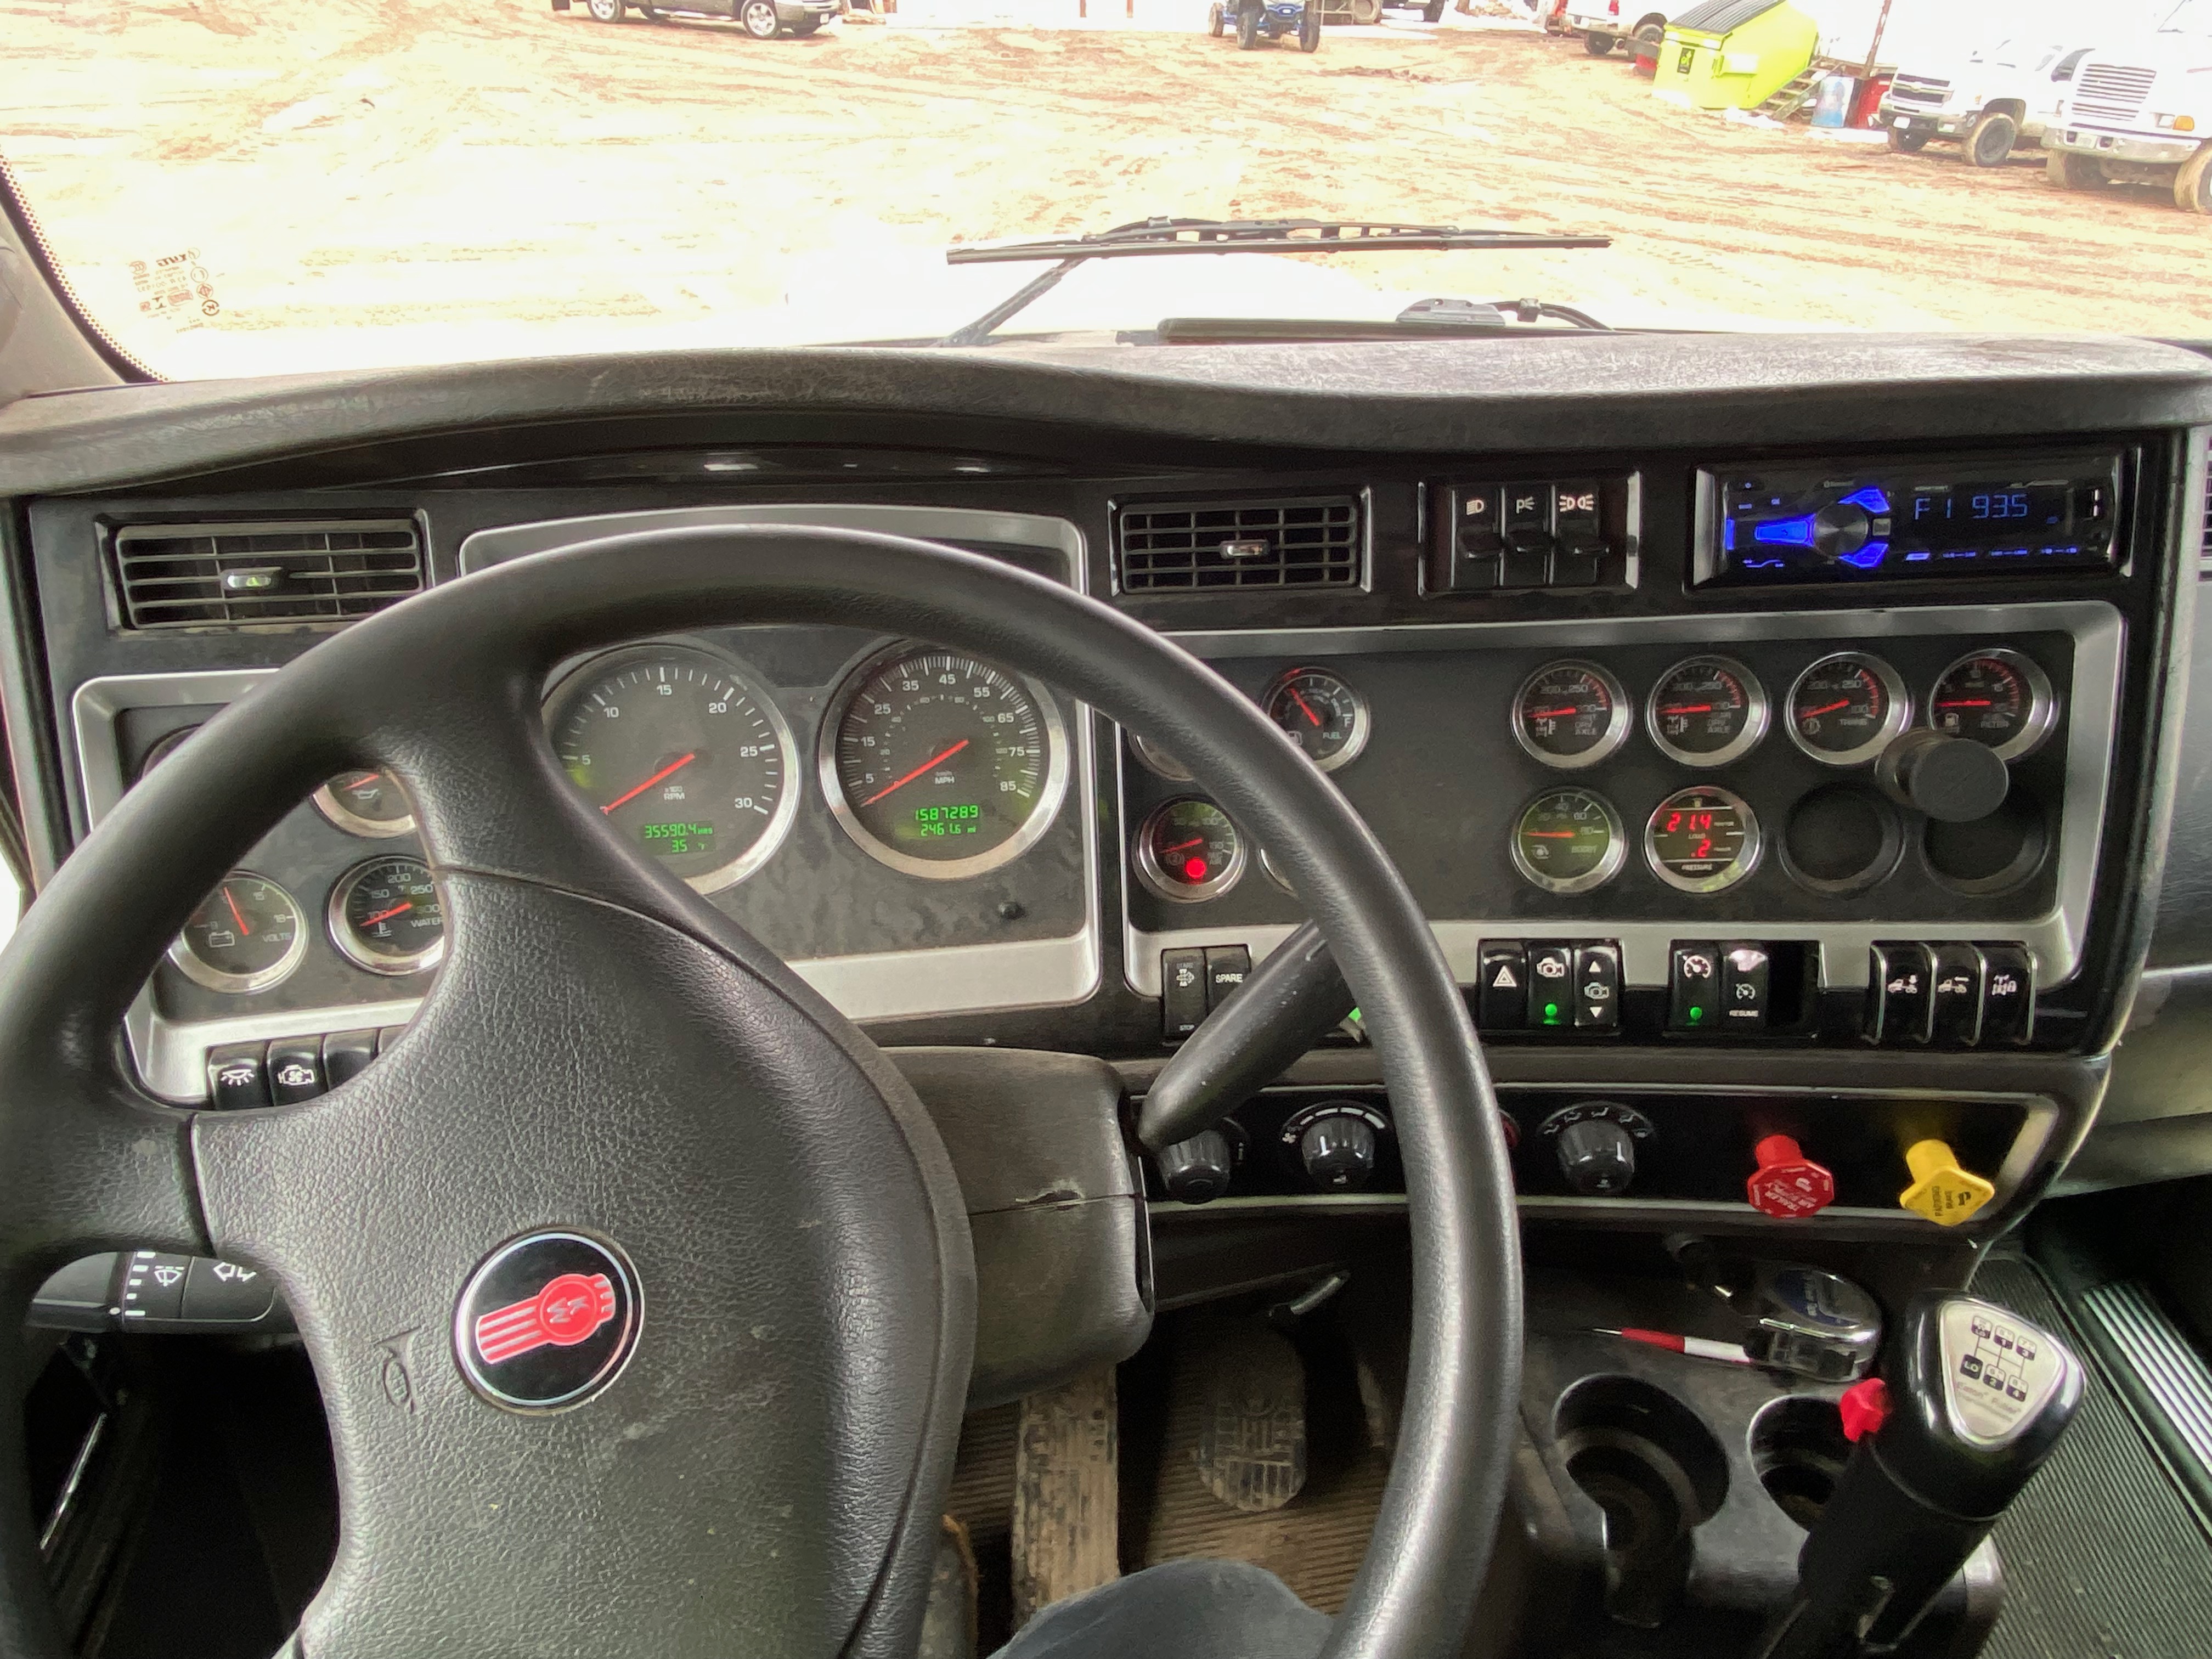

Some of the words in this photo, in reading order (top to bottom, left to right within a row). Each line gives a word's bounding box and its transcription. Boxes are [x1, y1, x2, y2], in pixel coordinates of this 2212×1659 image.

[939, 674, 956, 685] 45
[657, 685, 673, 696] 15
[902, 680, 919, 691] 35
[1568, 684, 1588, 693] 250
[973, 687, 990, 698] 55
[603, 707, 619, 718] 10
[708, 703, 727, 714] 20
[874, 704, 891, 715] 25
[997, 713, 1014, 724] 65
[1344, 717, 1351, 727] F
[861, 736, 876, 747] 15
[740, 746, 758, 757] 25
[1008, 747, 1025, 757] 75
[582, 755, 591, 765] 5
[865, 774, 874, 783] 5
[935, 776, 955, 785] MPH
[1000, 781, 1017, 792] 85
[663, 792, 686, 800] RPM
[735, 798, 753, 809] 30
[915, 805, 979, 821] 1587289
[671, 839, 688, 853] 35
[387, 873, 411, 883] 200
[410, 884, 434, 895] 250
[262, 933, 292, 943] VOLTS
[1215, 973, 1244, 983] SPARE
[1964, 1360, 1979, 1370] LO
